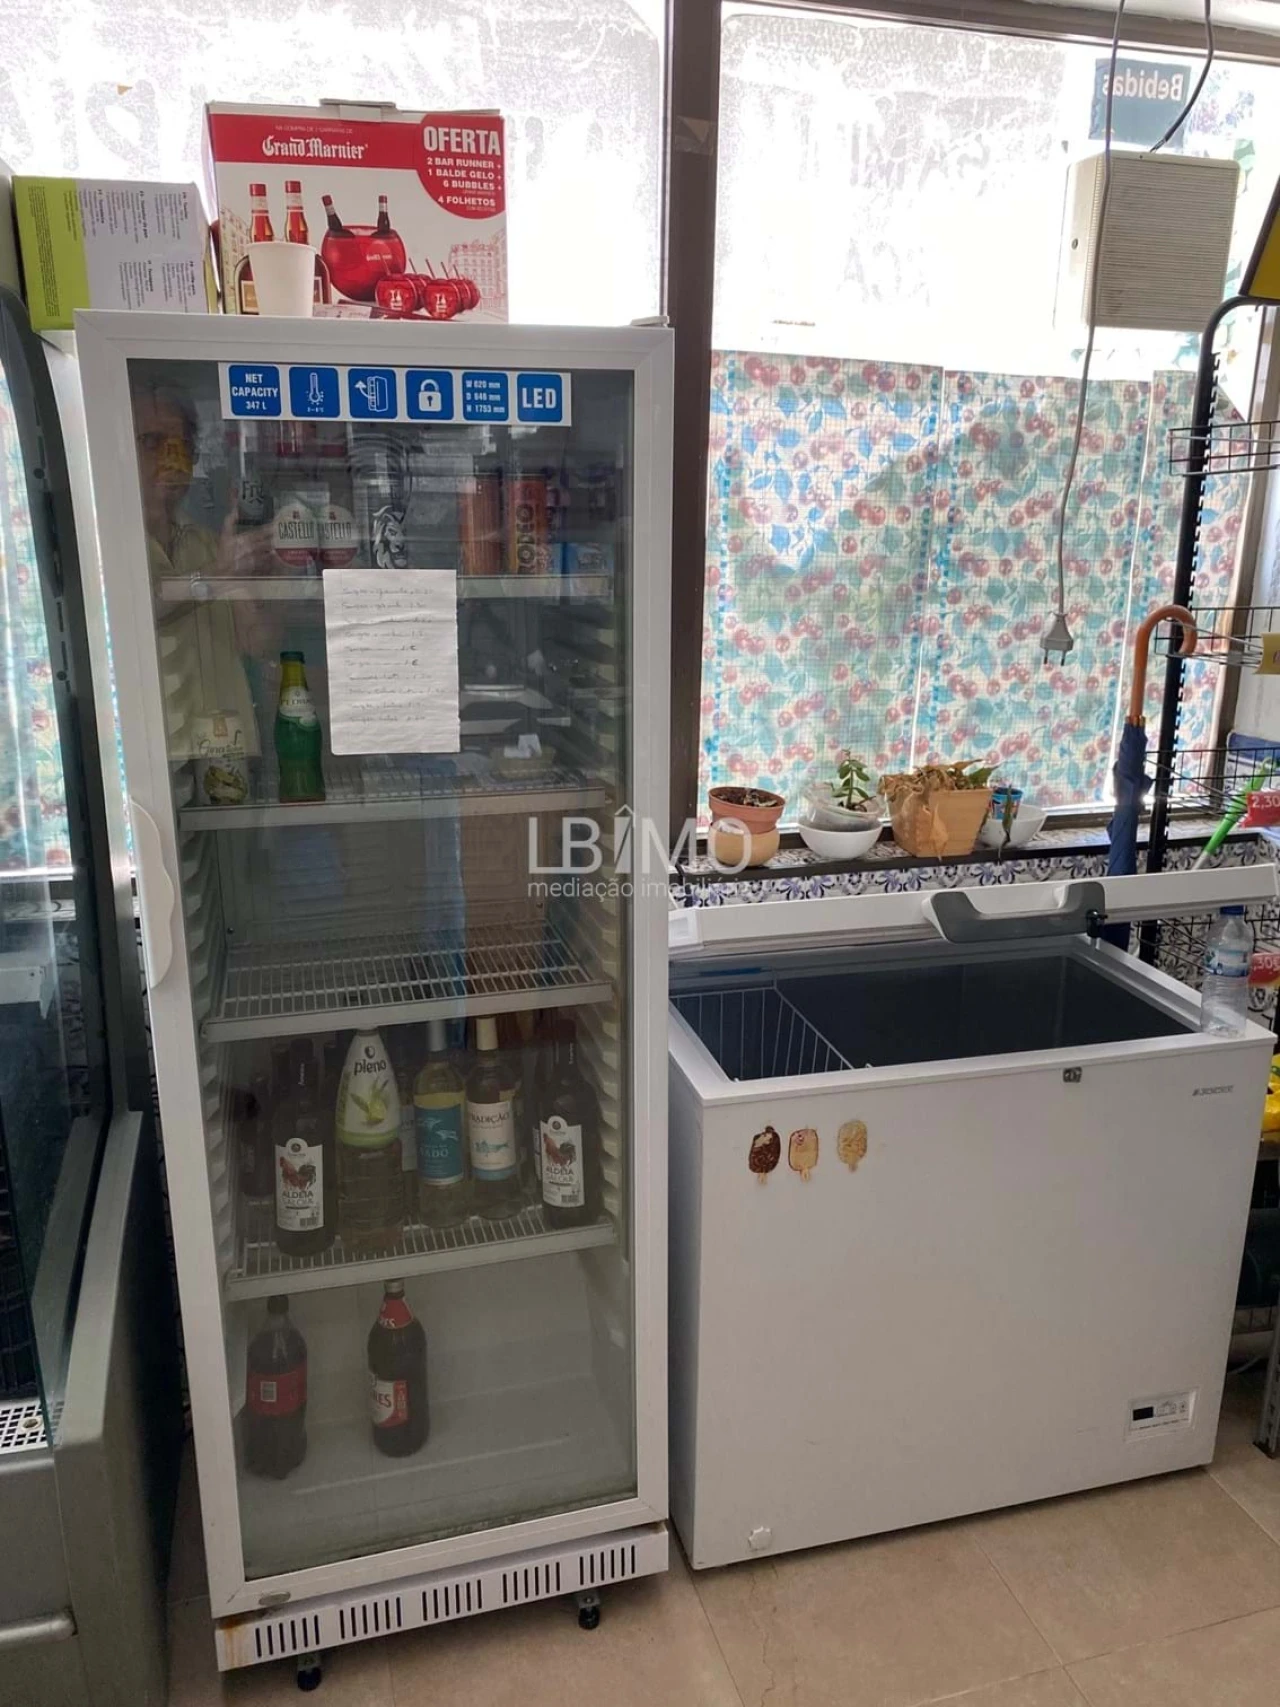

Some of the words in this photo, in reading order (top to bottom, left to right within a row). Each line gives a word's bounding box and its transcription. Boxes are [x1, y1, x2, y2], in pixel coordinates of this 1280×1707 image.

[423, 126, 501, 155] OFERTA
[262, 135, 305, 157] Grand
[305, 137, 365, 159] Marnier
[427, 157, 433, 166] 2
[435, 158, 454, 166] BAR
[456, 158, 494, 169] RUNNER
[428, 168, 433, 176] 1
[436, 168, 467, 178] BALDE
[469, 171, 495, 180] GELO
[443, 180, 449, 188] 6
[452, 181, 495, 191] BUBBLES
[438, 196, 444, 204] 4
[446, 196, 496, 207] FOLHETOS
[245, 373, 263, 384] NET
[231, 387, 279, 398] CAPACITY
[521, 387, 557, 409] LED
[245, 401, 260, 410] 347
[262, 402, 267, 410] L
[353, 1058, 387, 1076] pleno
